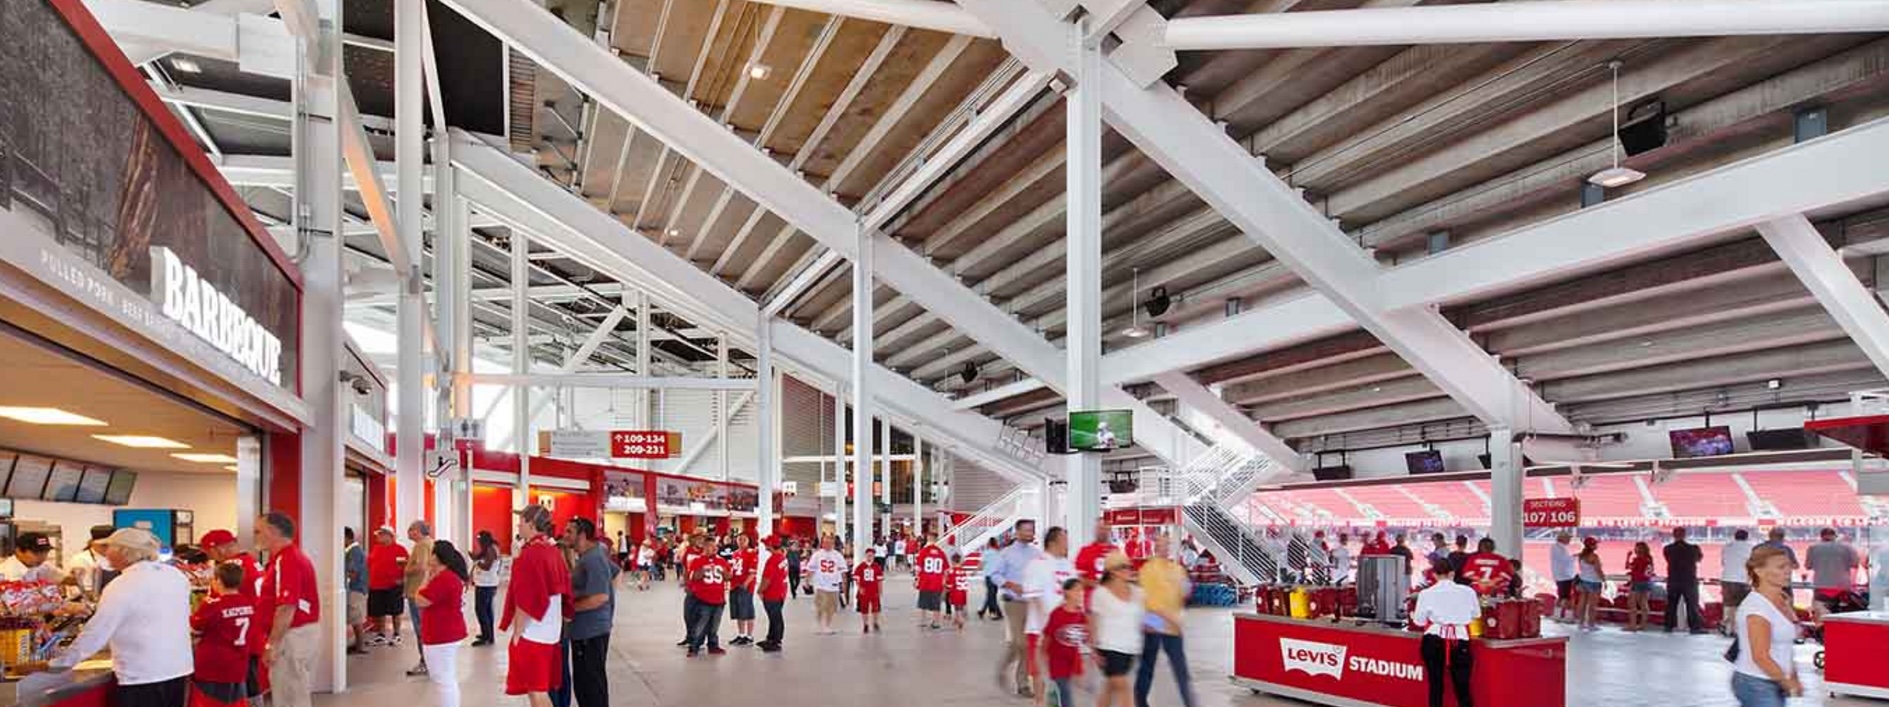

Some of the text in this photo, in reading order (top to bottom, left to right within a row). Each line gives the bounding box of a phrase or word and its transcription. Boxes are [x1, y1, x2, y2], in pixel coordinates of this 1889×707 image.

[158, 246, 281, 387] BARBEQUE
[623, 434, 665, 443] 109-134
[623, 445, 665, 454] 209-231
[1524, 512, 1547, 524] 107
[1549, 511, 1577, 524] 106
[819, 559, 834, 573] 52
[923, 557, 943, 574] 80
[1480, 566, 1493, 581] 7
[233, 617, 250, 646] 7
[1349, 656, 1424, 681] STADIUM
